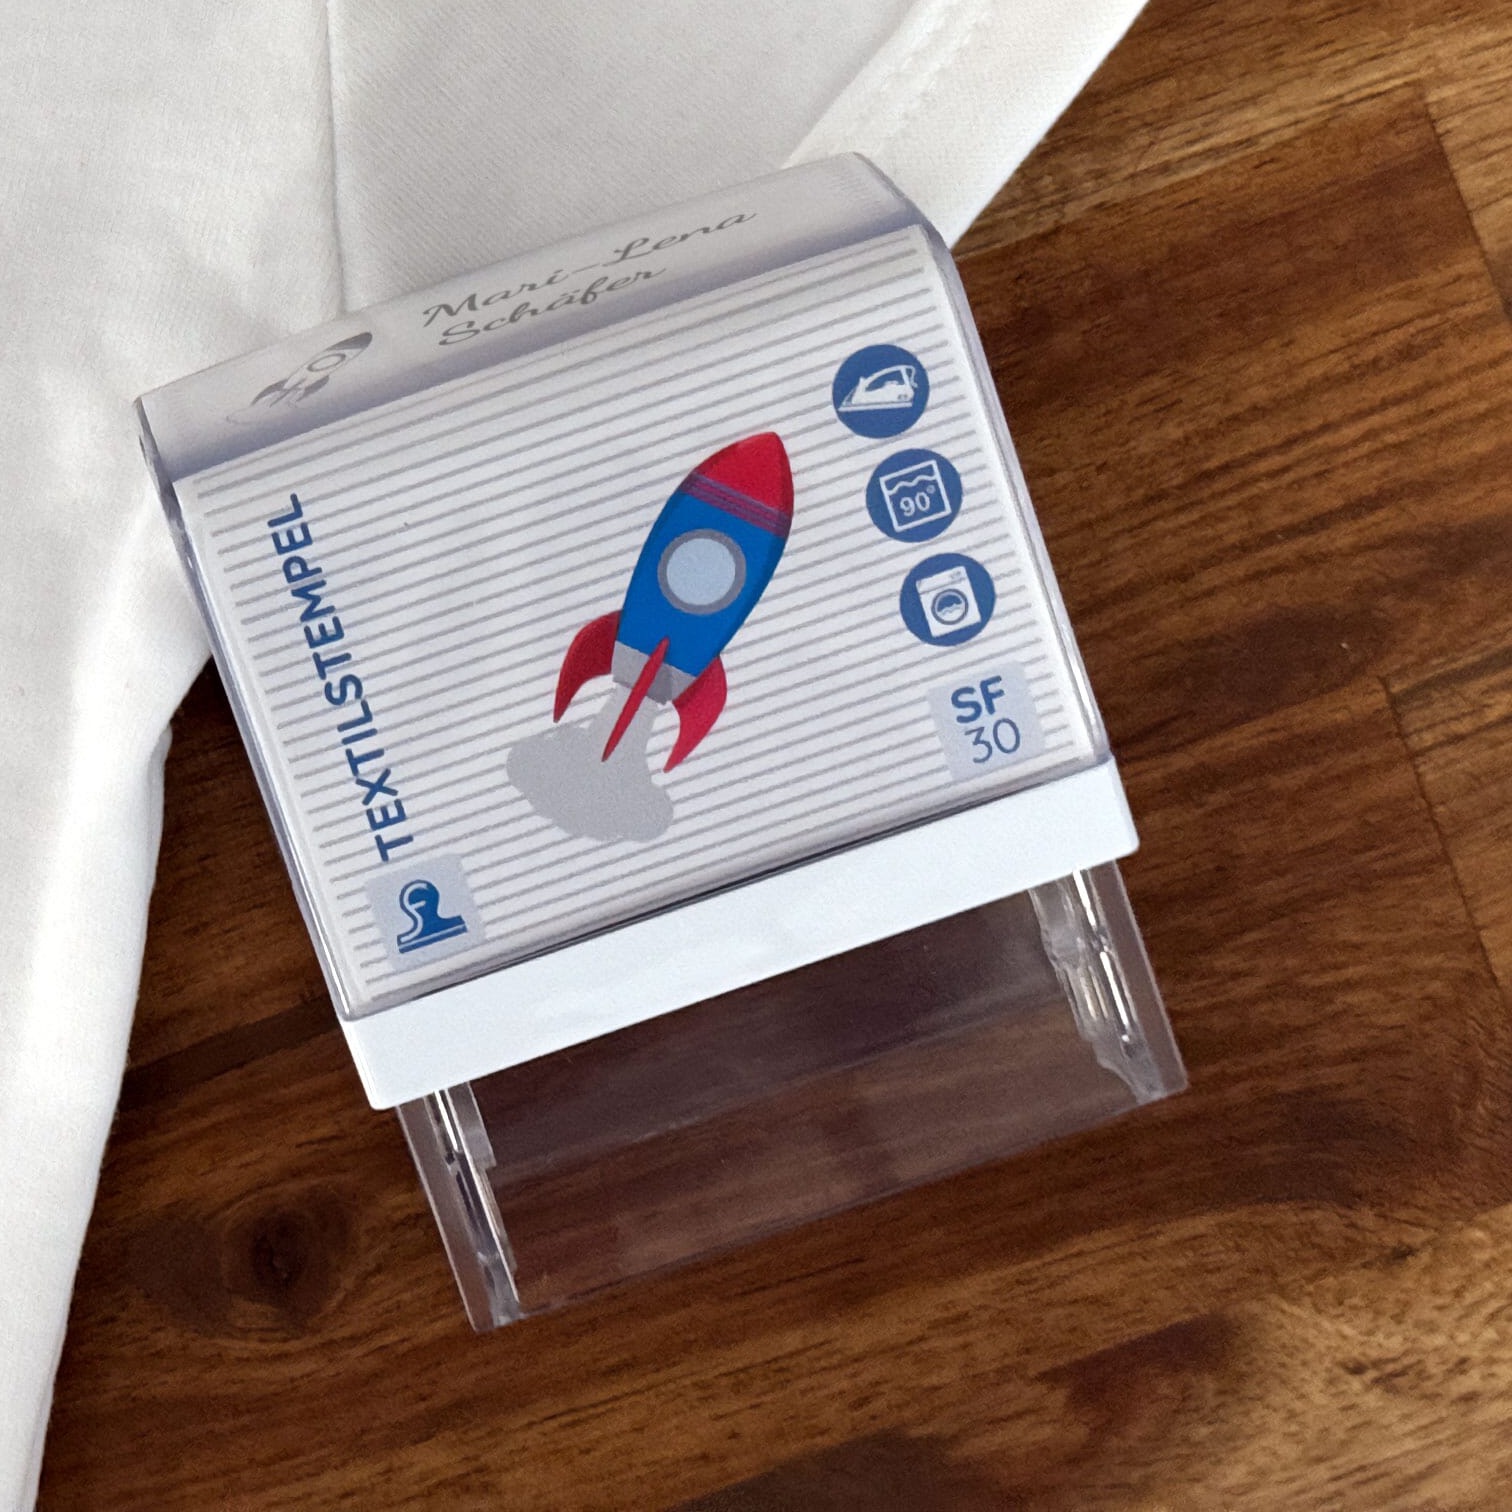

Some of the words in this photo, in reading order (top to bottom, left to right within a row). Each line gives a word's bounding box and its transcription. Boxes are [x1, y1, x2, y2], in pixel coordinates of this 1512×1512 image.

[422, 208, 759, 329] Mari-Lena
[437, 266, 667, 347] Schäfer
[267, 493, 414, 862] TEXTILSTEMPEL
[950, 675, 1005, 724] SF
[964, 718, 1021, 764] 30
